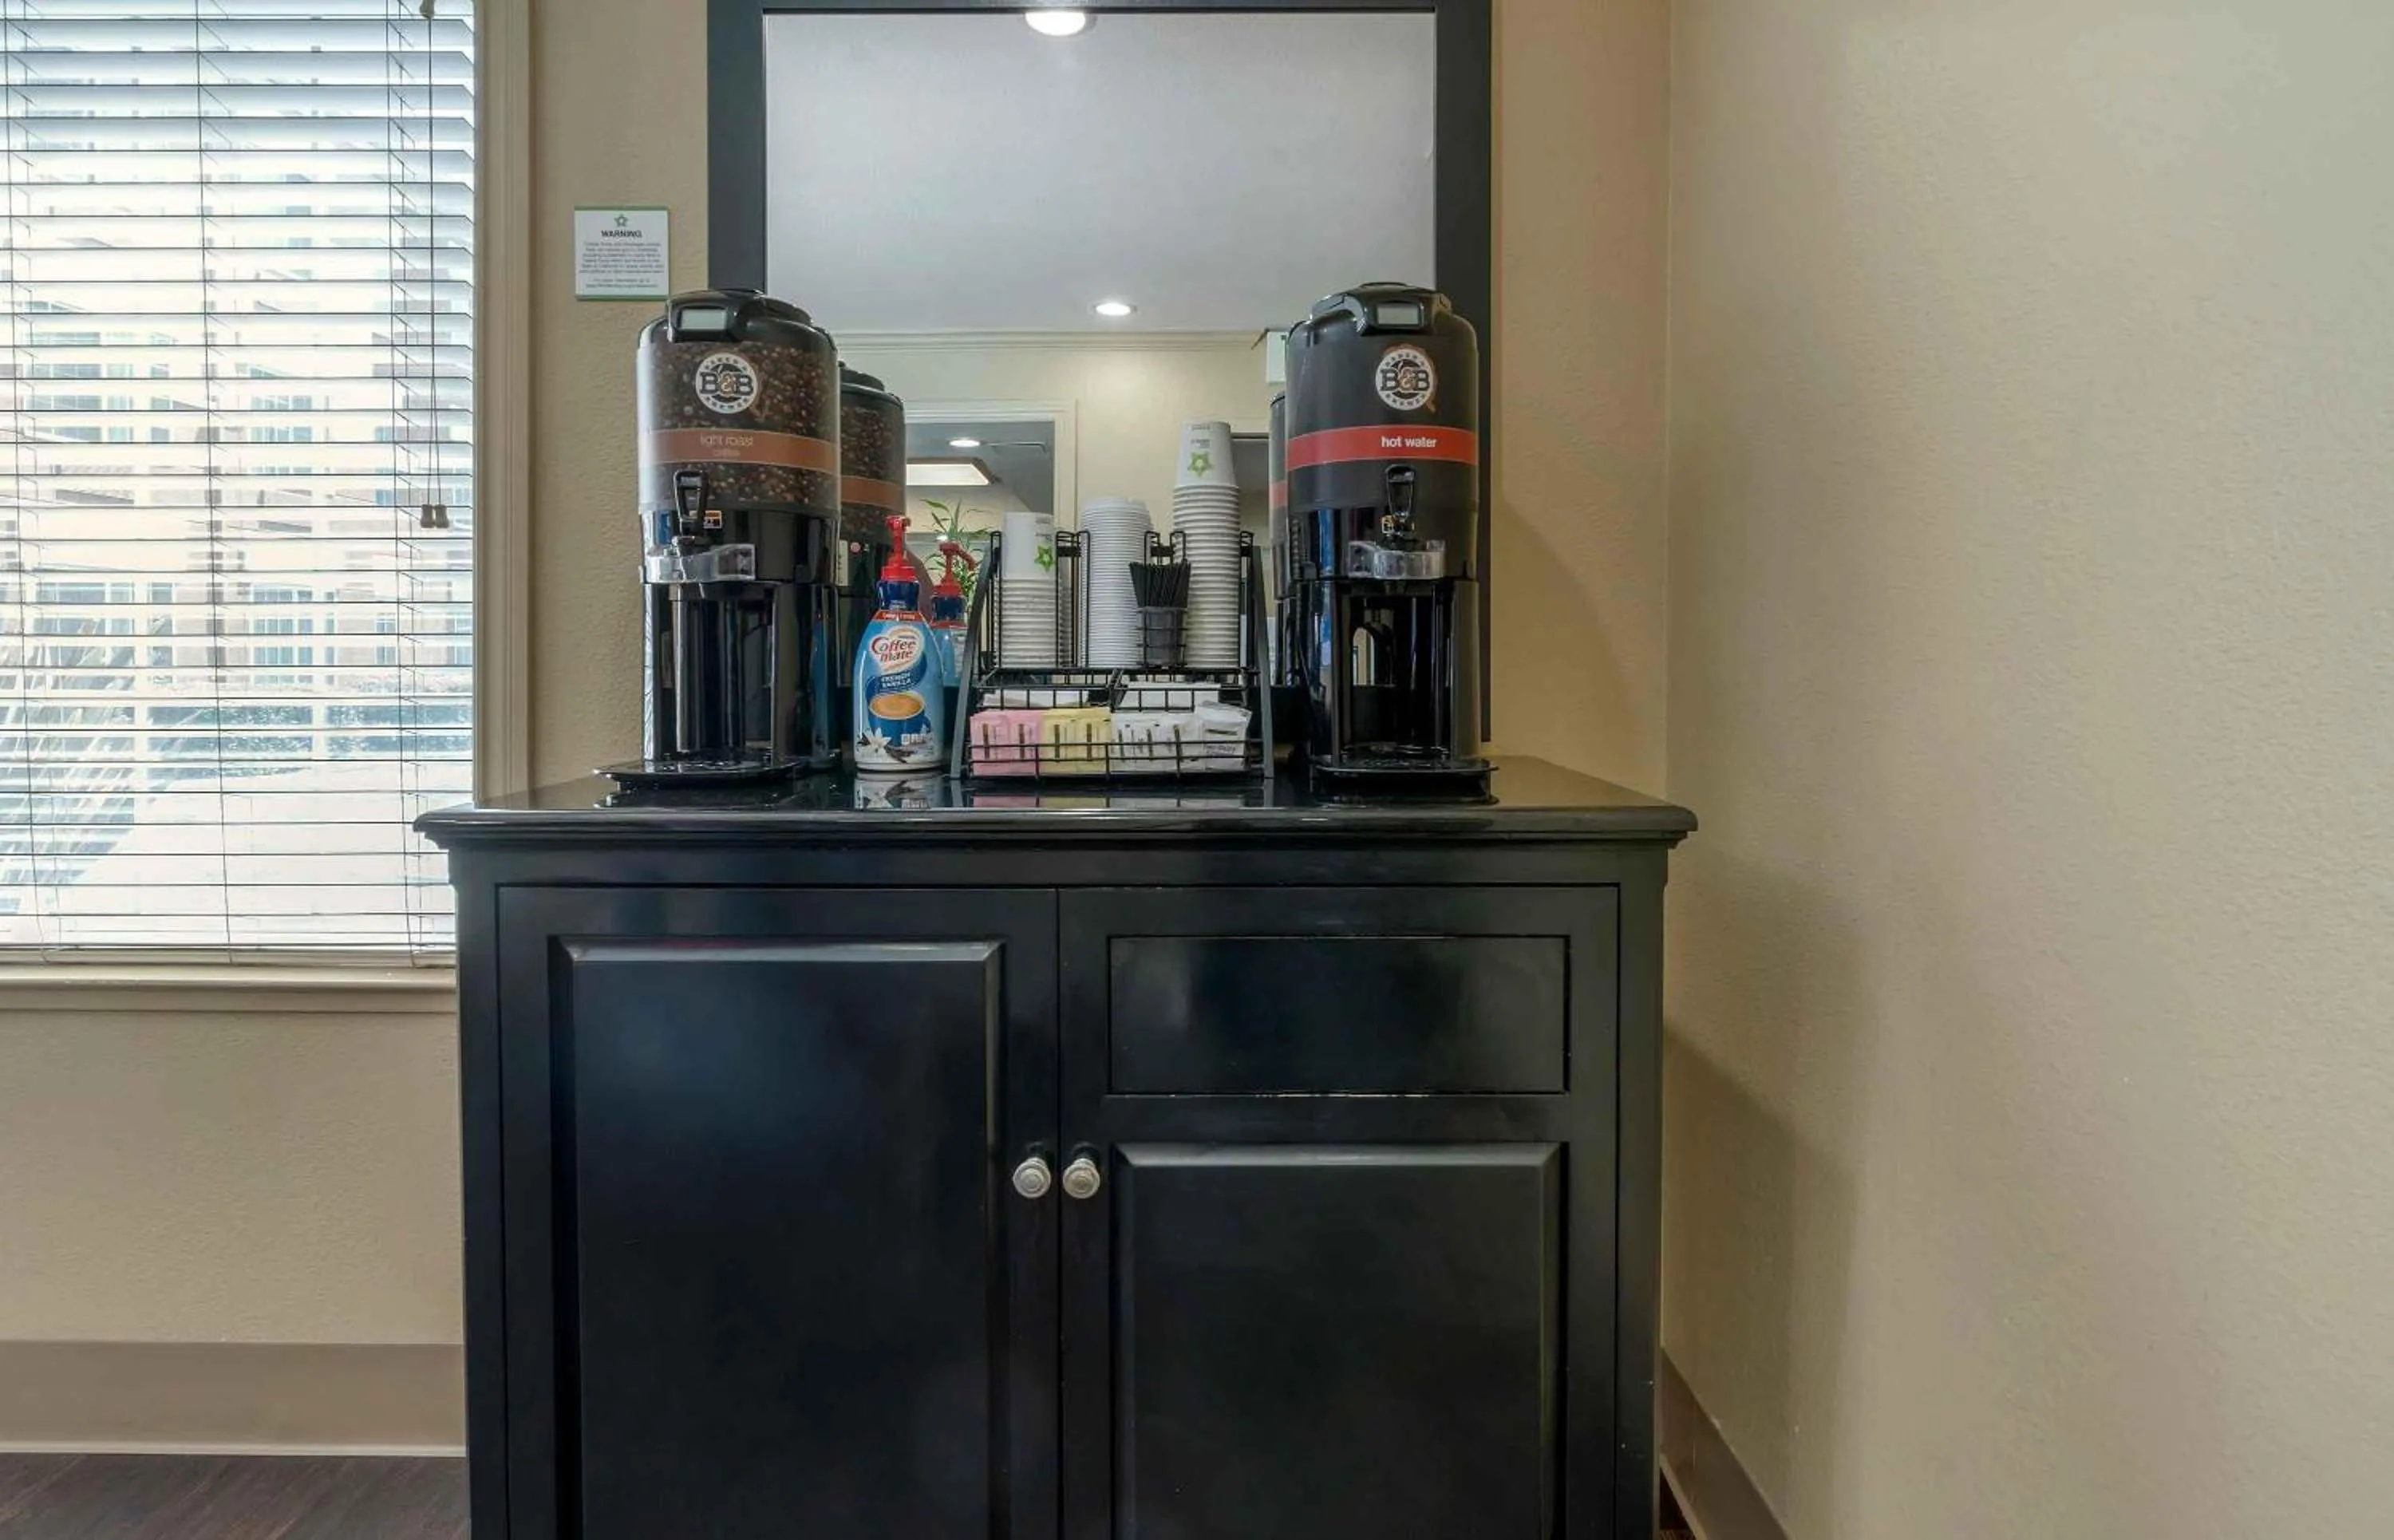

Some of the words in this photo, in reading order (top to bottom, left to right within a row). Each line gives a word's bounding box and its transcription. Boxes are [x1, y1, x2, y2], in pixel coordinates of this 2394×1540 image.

[601, 230, 642, 239] WARNING
[1381, 436, 1402, 448] hot
[1404, 436, 1437, 448] water
[871, 636, 917, 654] Coffee
